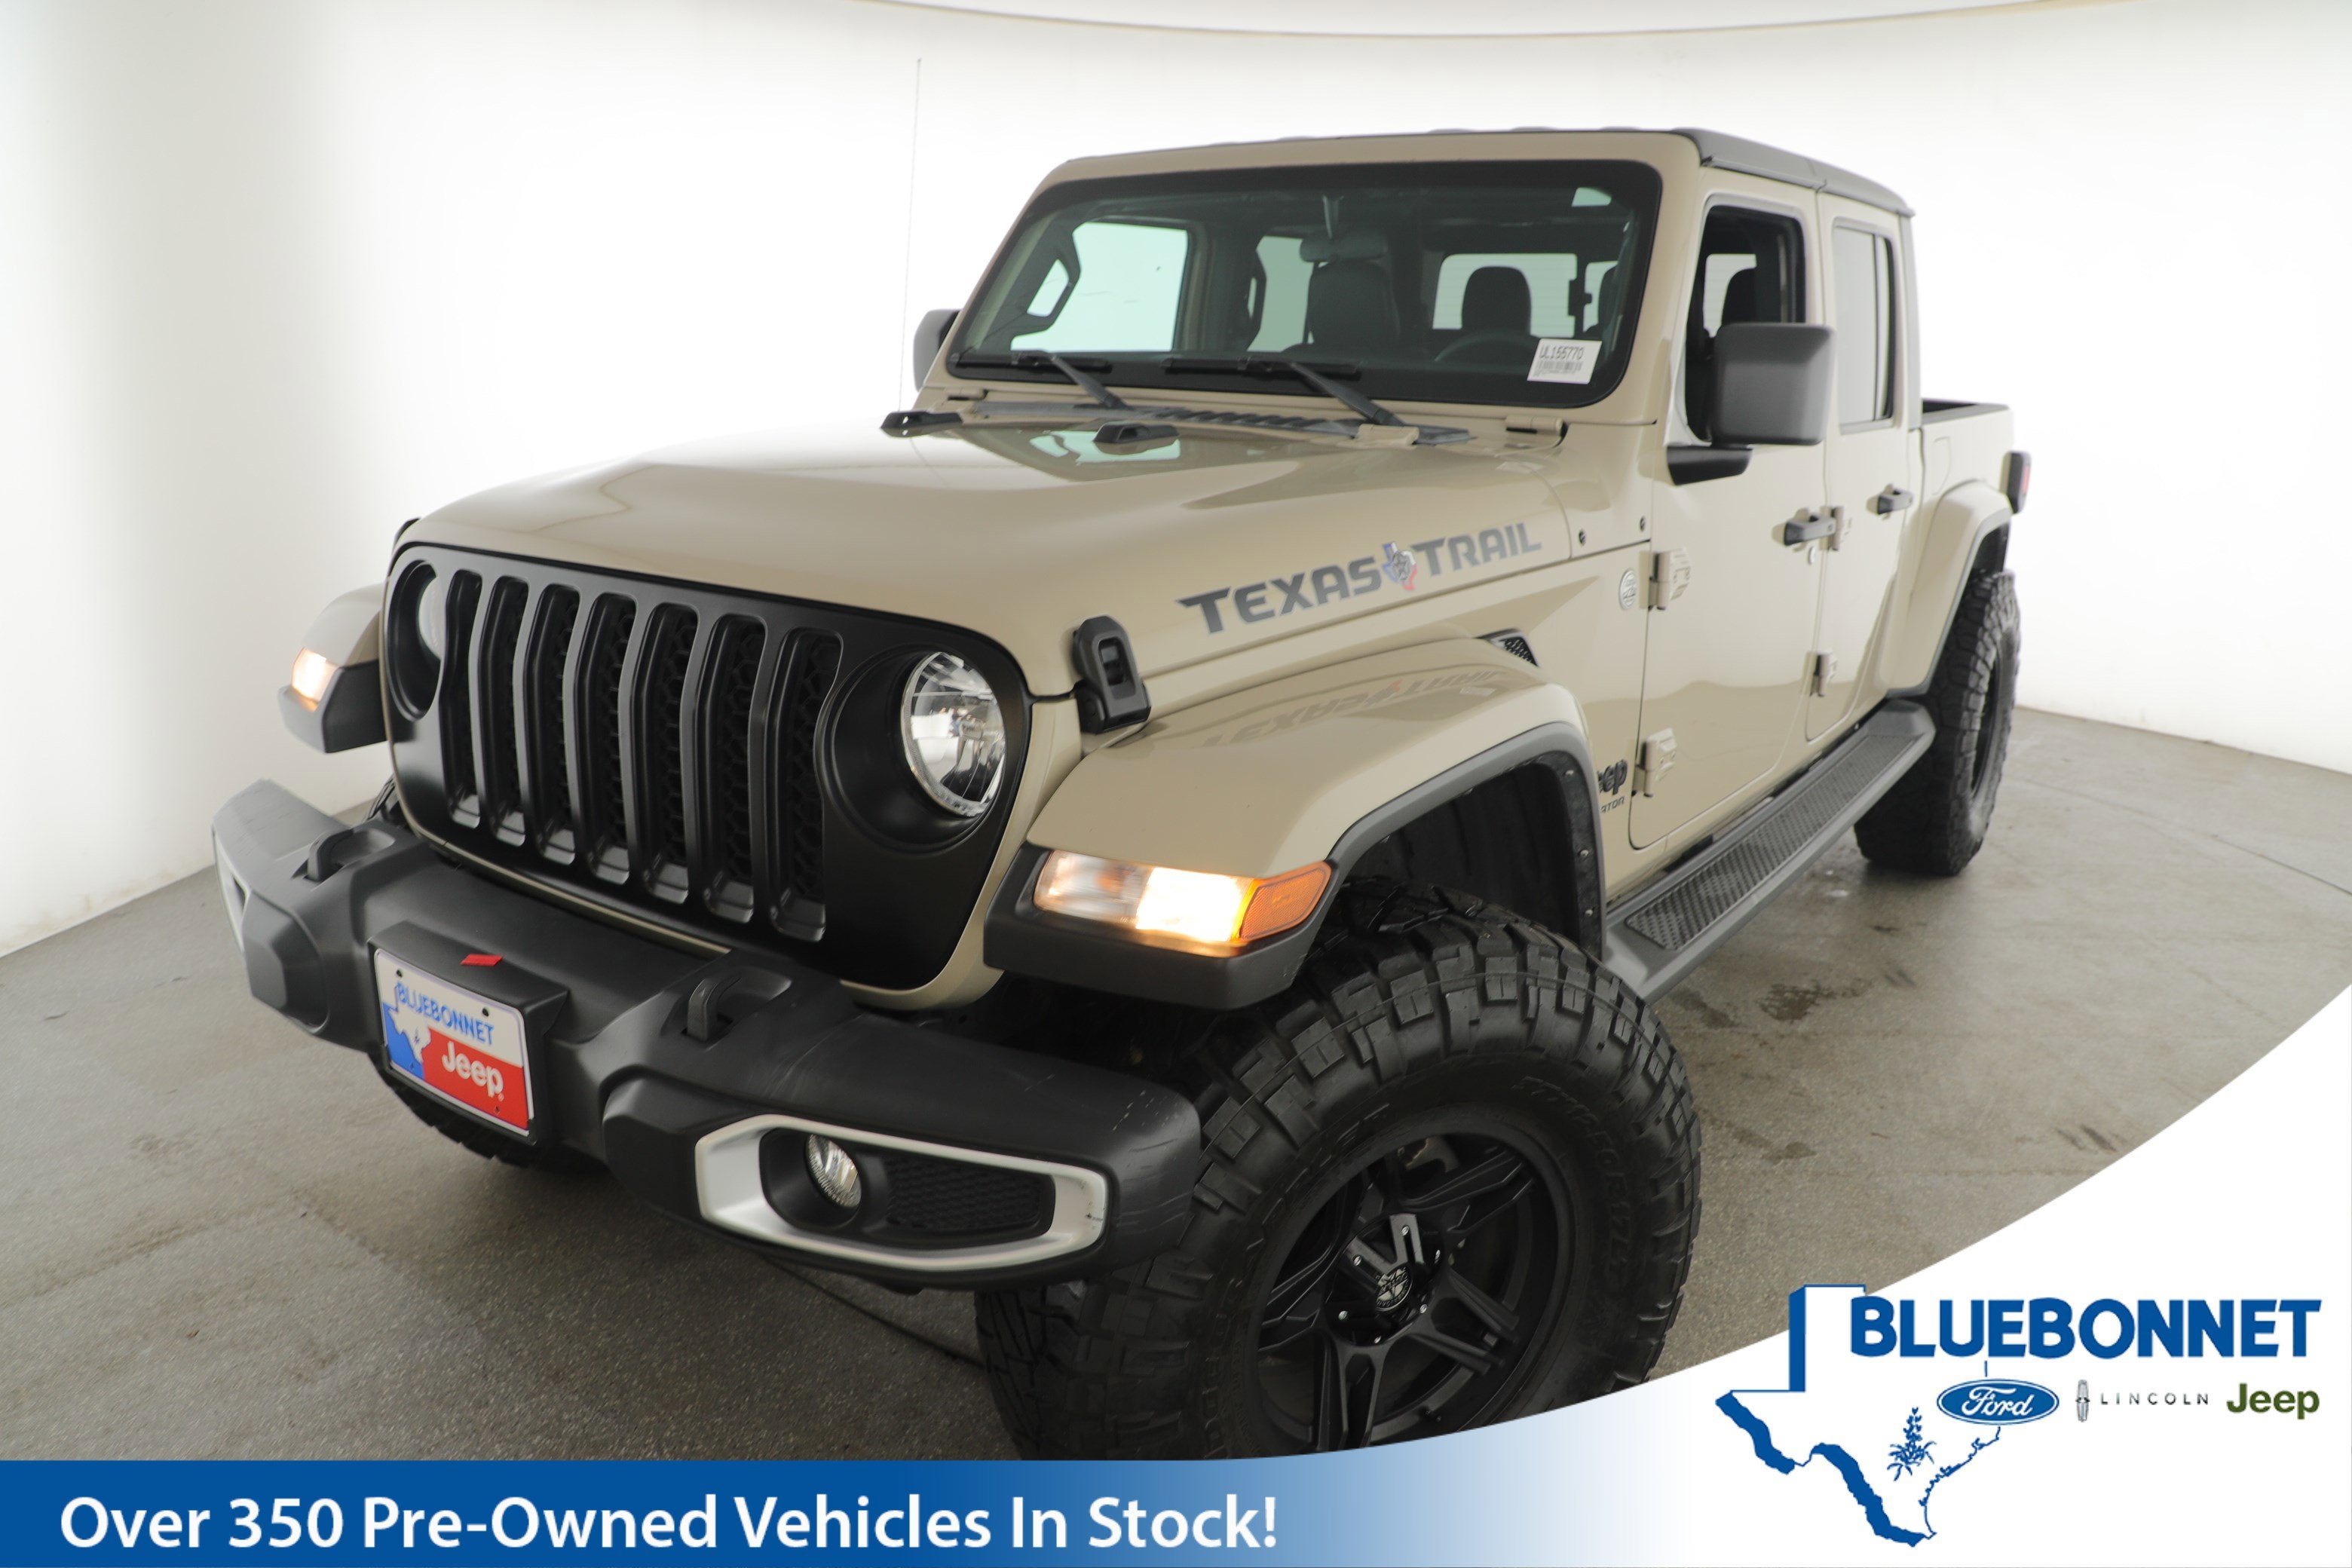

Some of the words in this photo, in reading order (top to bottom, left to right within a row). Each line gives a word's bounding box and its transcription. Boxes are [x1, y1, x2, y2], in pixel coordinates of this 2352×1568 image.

[1176, 556, 1383, 635] TEXAS
[1410, 522, 1542, 577] TRAIL
[396, 982, 495, 1046] BLUEBONNET
[442, 1041, 504, 1098] Jeep
